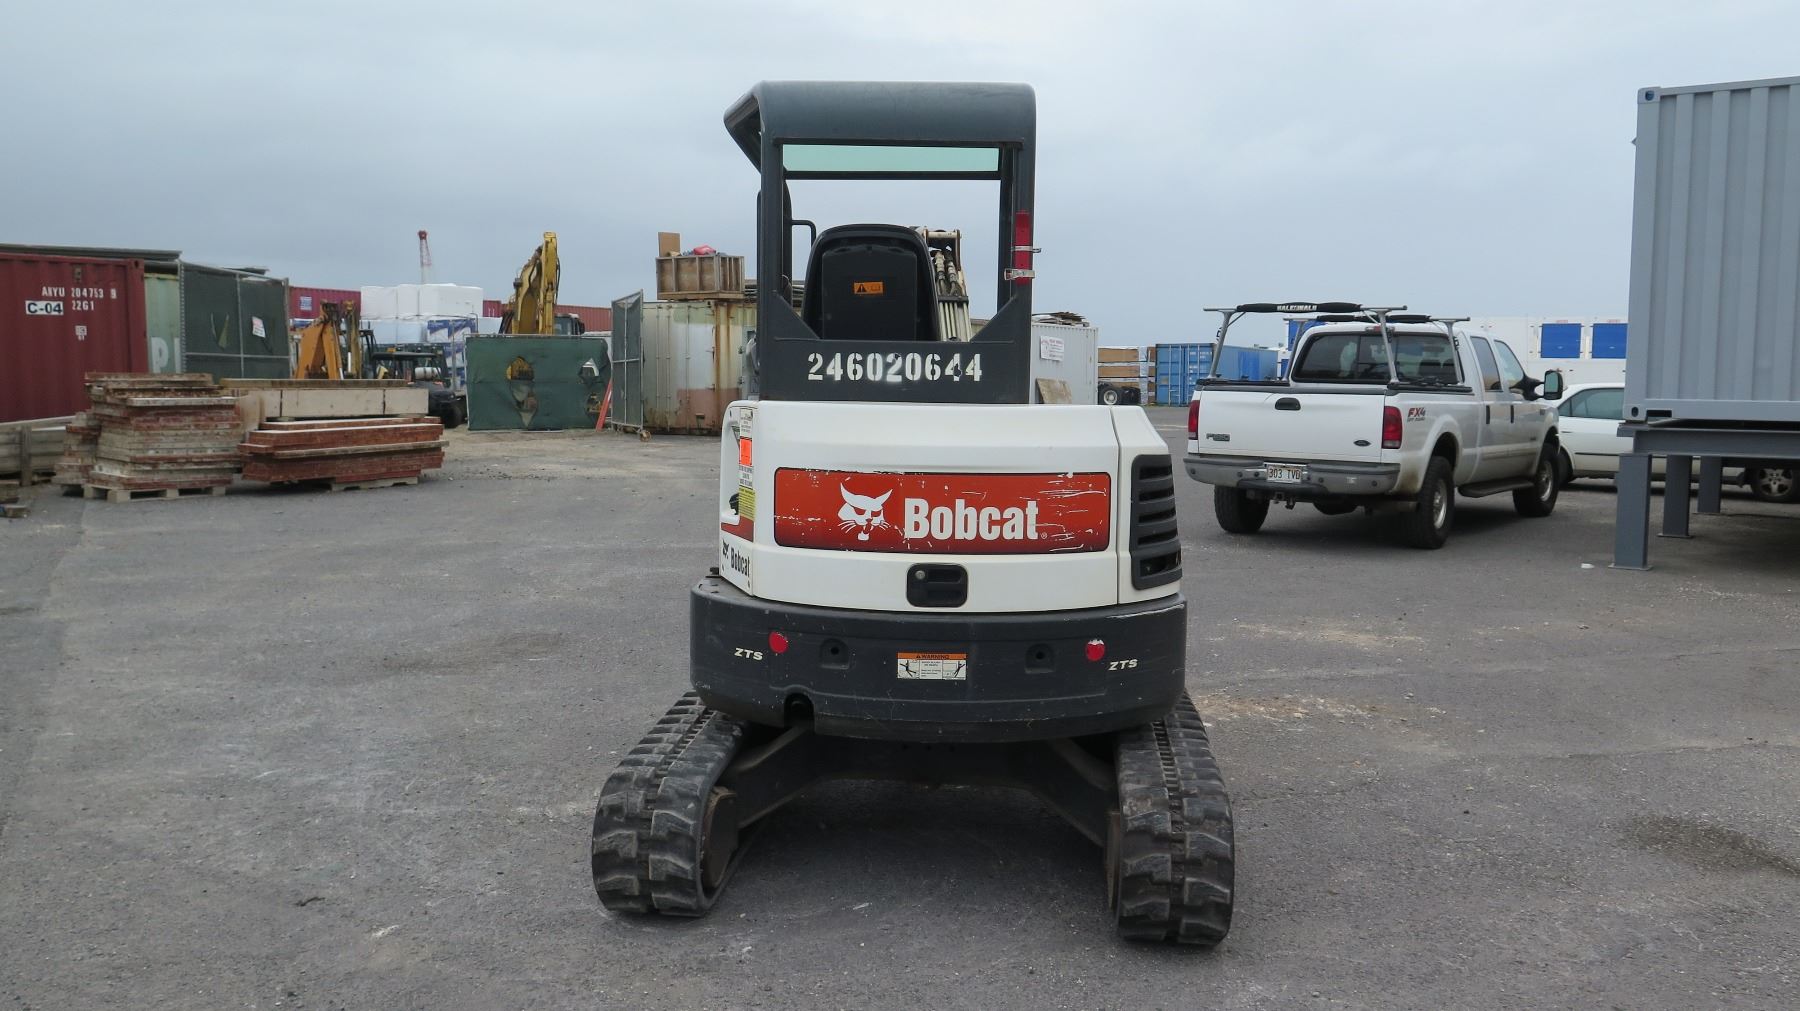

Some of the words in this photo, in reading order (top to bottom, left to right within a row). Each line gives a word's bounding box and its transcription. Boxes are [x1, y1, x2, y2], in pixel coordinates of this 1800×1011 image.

[27, 302, 63, 314] C-04
[807, 352, 983, 382] 246020644
[1407, 407, 1426, 418] FX4
[1268, 468, 1283, 479] 303
[904, 498, 1040, 541] Bobcat
[731, 547, 750, 578] Bobcat
[734, 647, 763, 661] ZTS
[1108, 659, 1138, 671] ZTS
